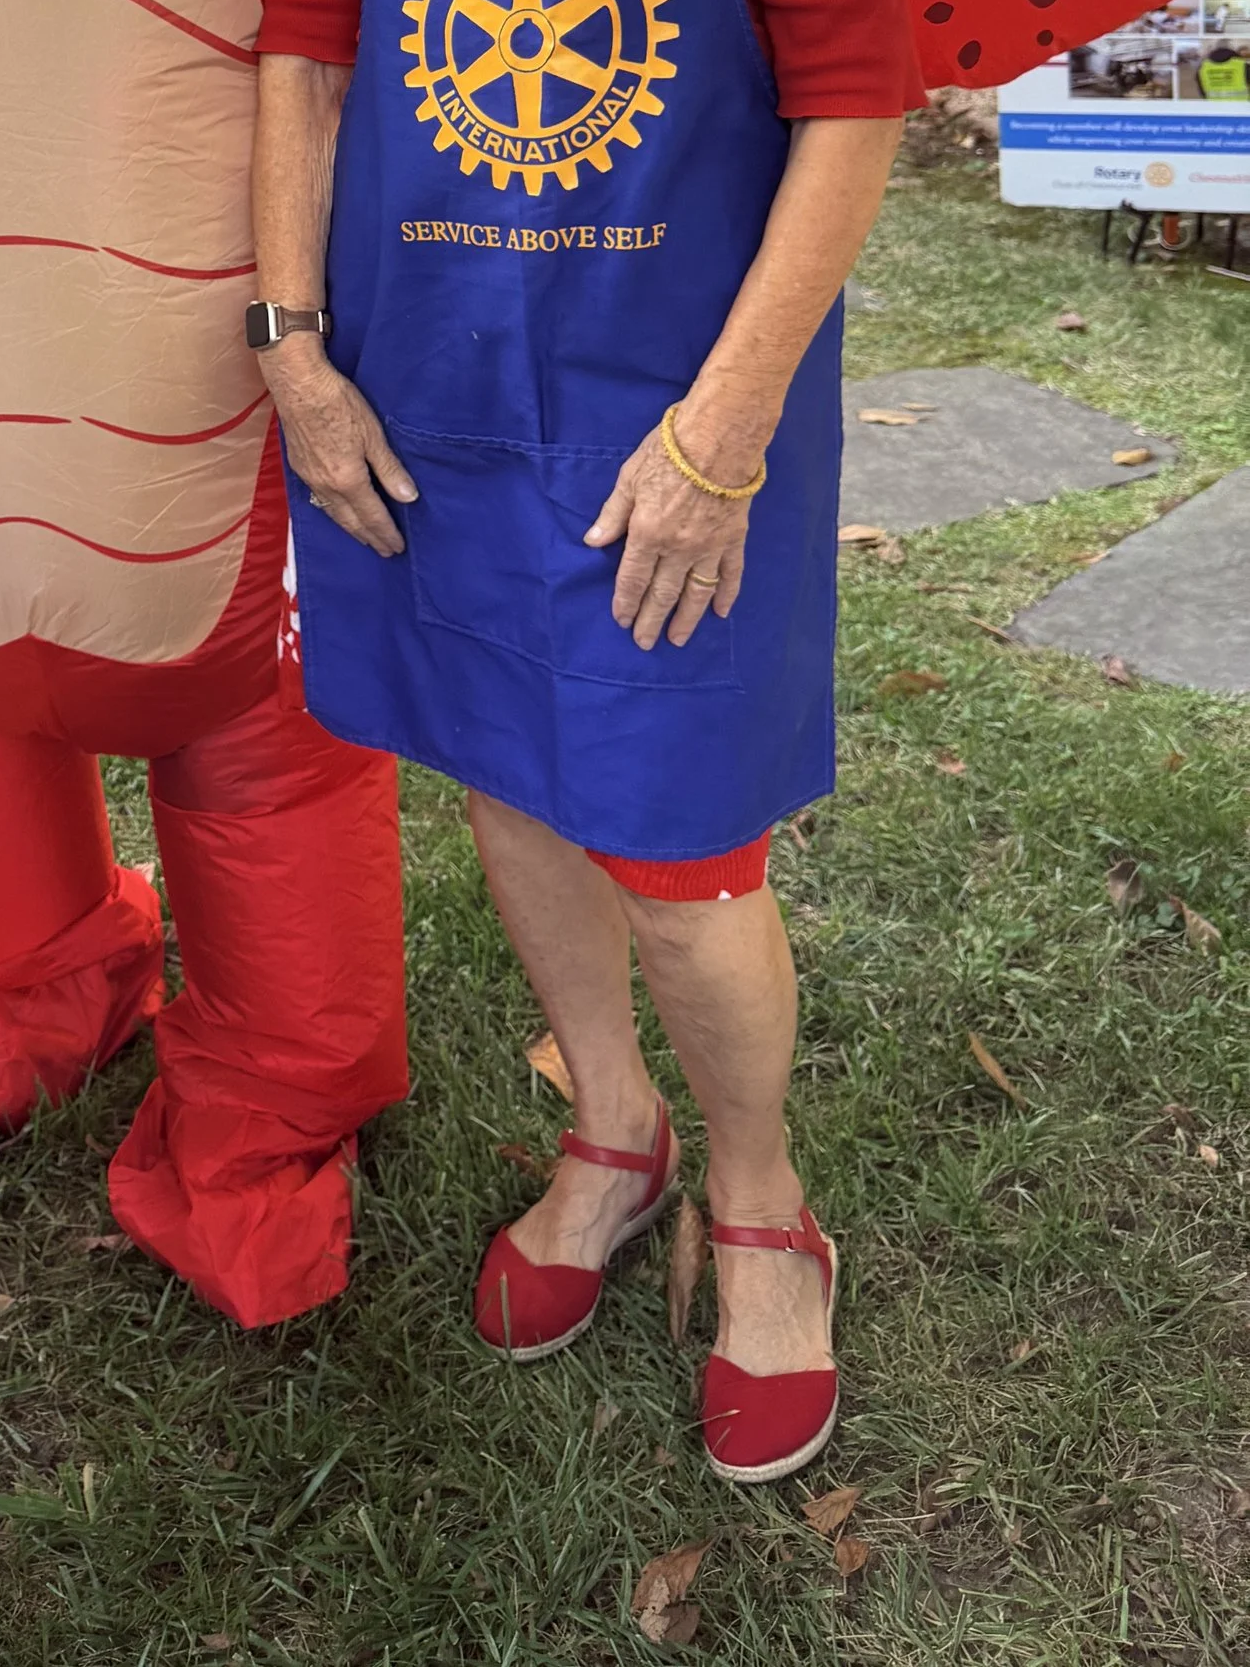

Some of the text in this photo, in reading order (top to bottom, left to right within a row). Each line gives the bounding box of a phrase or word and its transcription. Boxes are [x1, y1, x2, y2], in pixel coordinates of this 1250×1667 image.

[439, 83, 635, 162] INTERNATIONAL
[1094, 166, 1141, 182] Rotary
[400, 221, 667, 252] SERVICE ABOVE SELF
